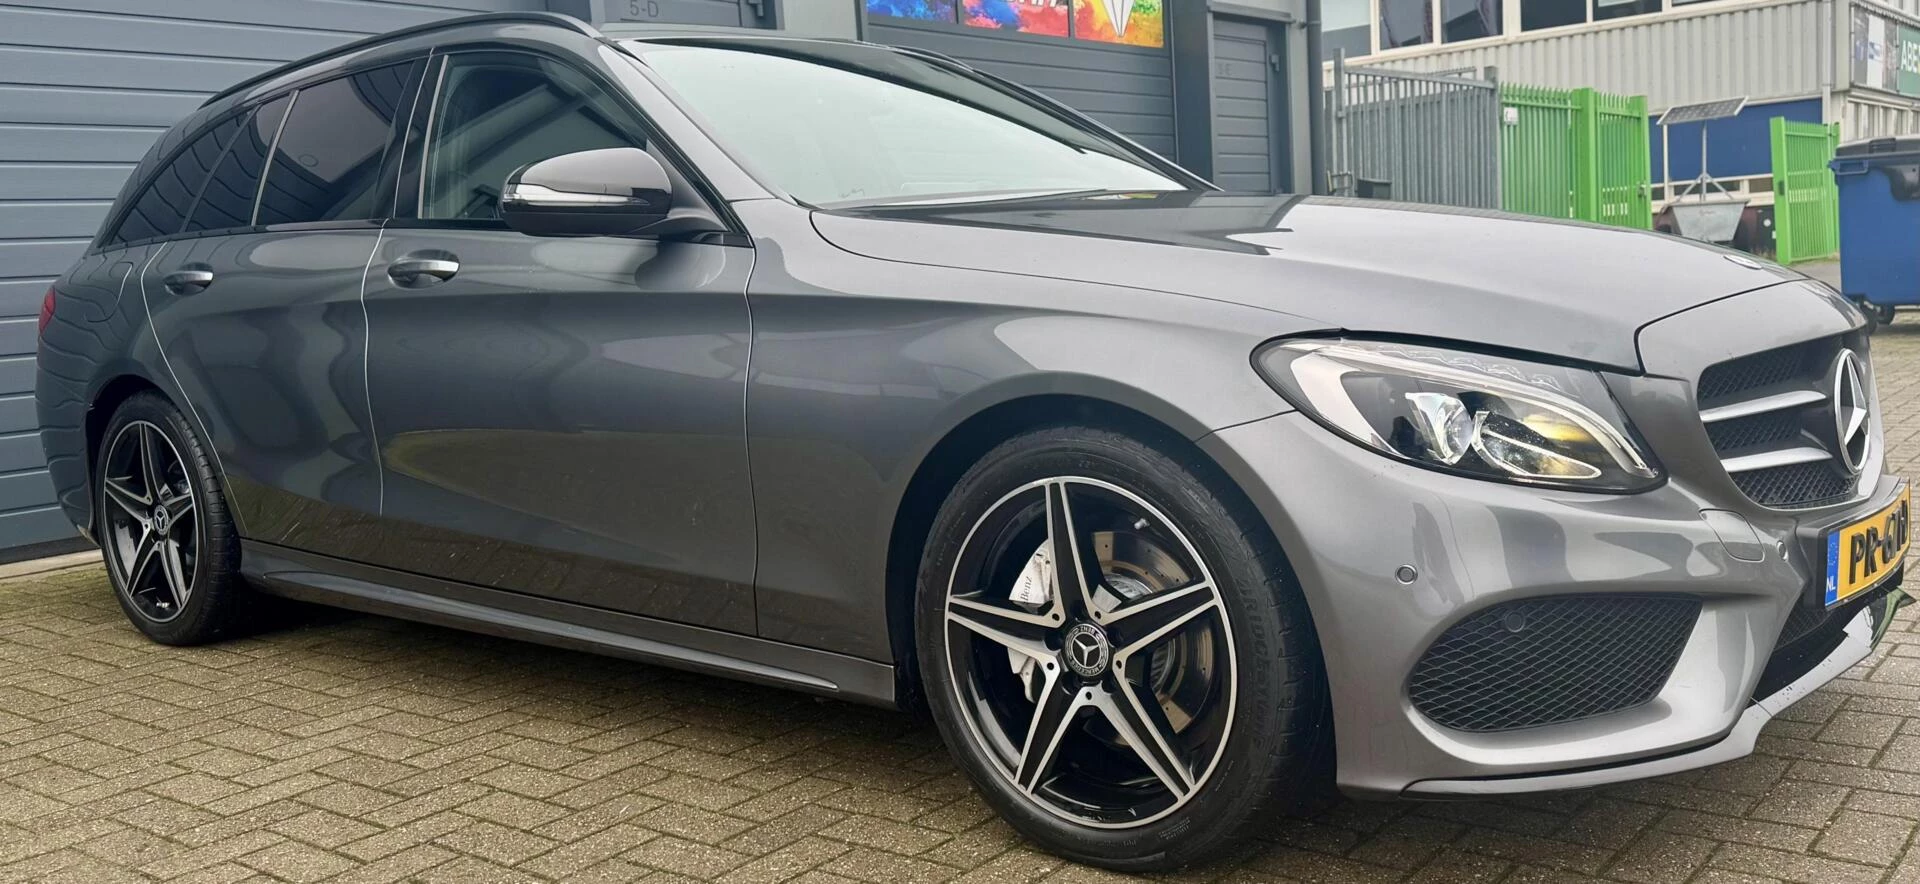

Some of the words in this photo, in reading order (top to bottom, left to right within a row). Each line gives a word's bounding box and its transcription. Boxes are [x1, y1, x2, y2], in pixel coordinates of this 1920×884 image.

[630, 0, 659, 18] 5-D
[1020, 576, 1032, 601] Benz
[1826, 577, 1836, 592] NL
